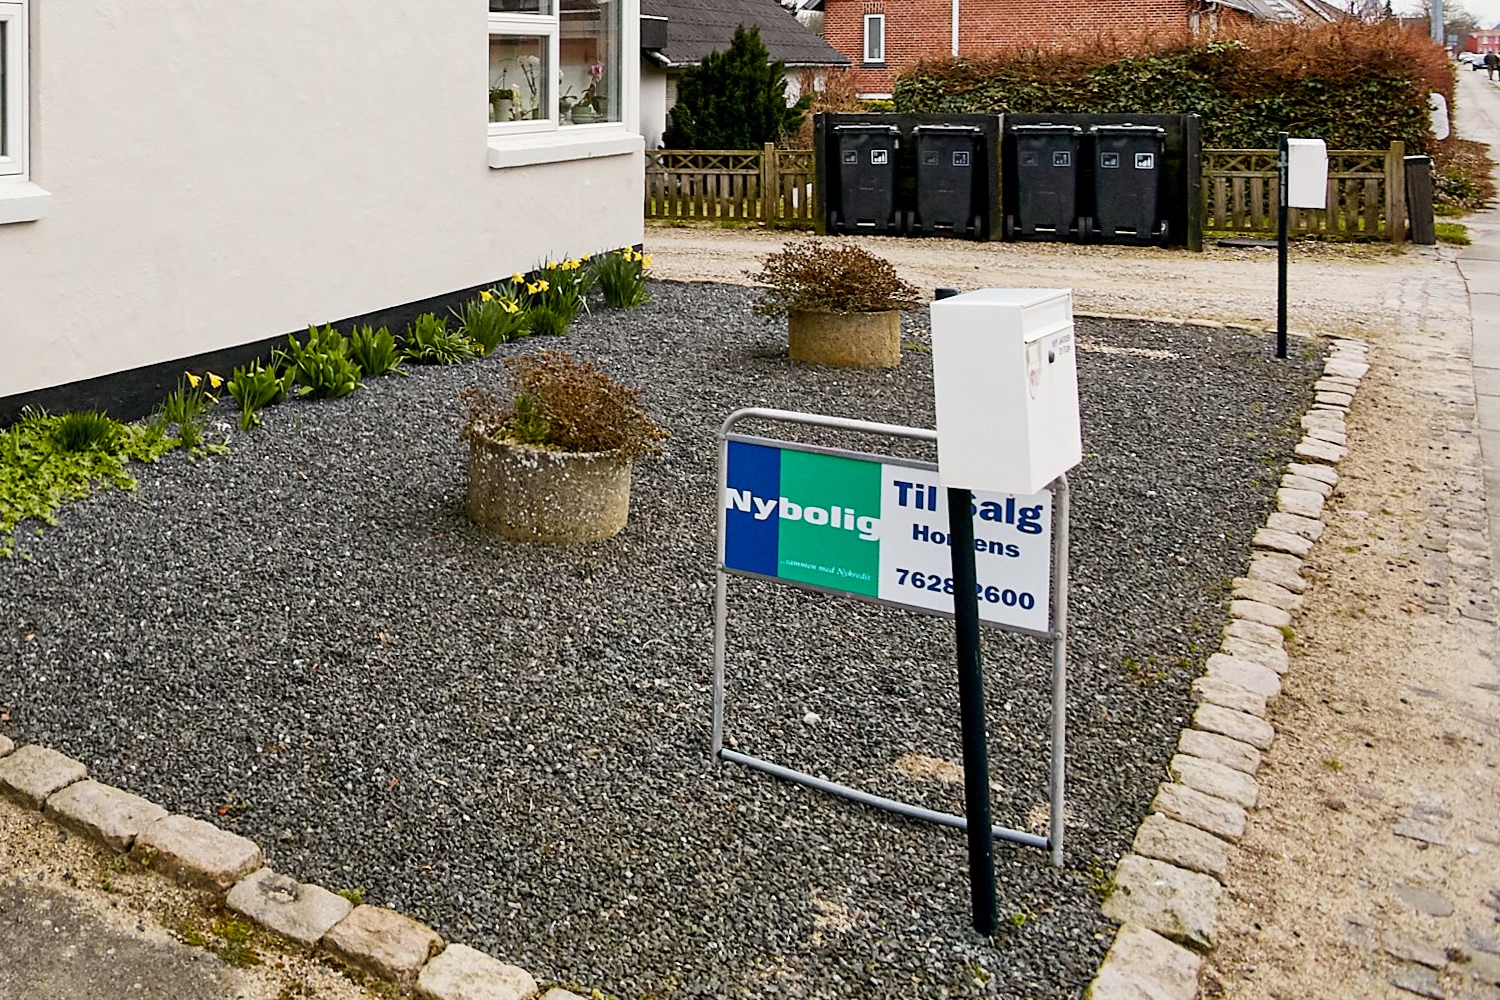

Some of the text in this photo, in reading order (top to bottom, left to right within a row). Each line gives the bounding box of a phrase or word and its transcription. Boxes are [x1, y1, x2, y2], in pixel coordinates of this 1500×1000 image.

[893, 480, 937, 512] Til
[726, 487, 881, 542] Nybolig
[895, 568, 954, 595] 7628
